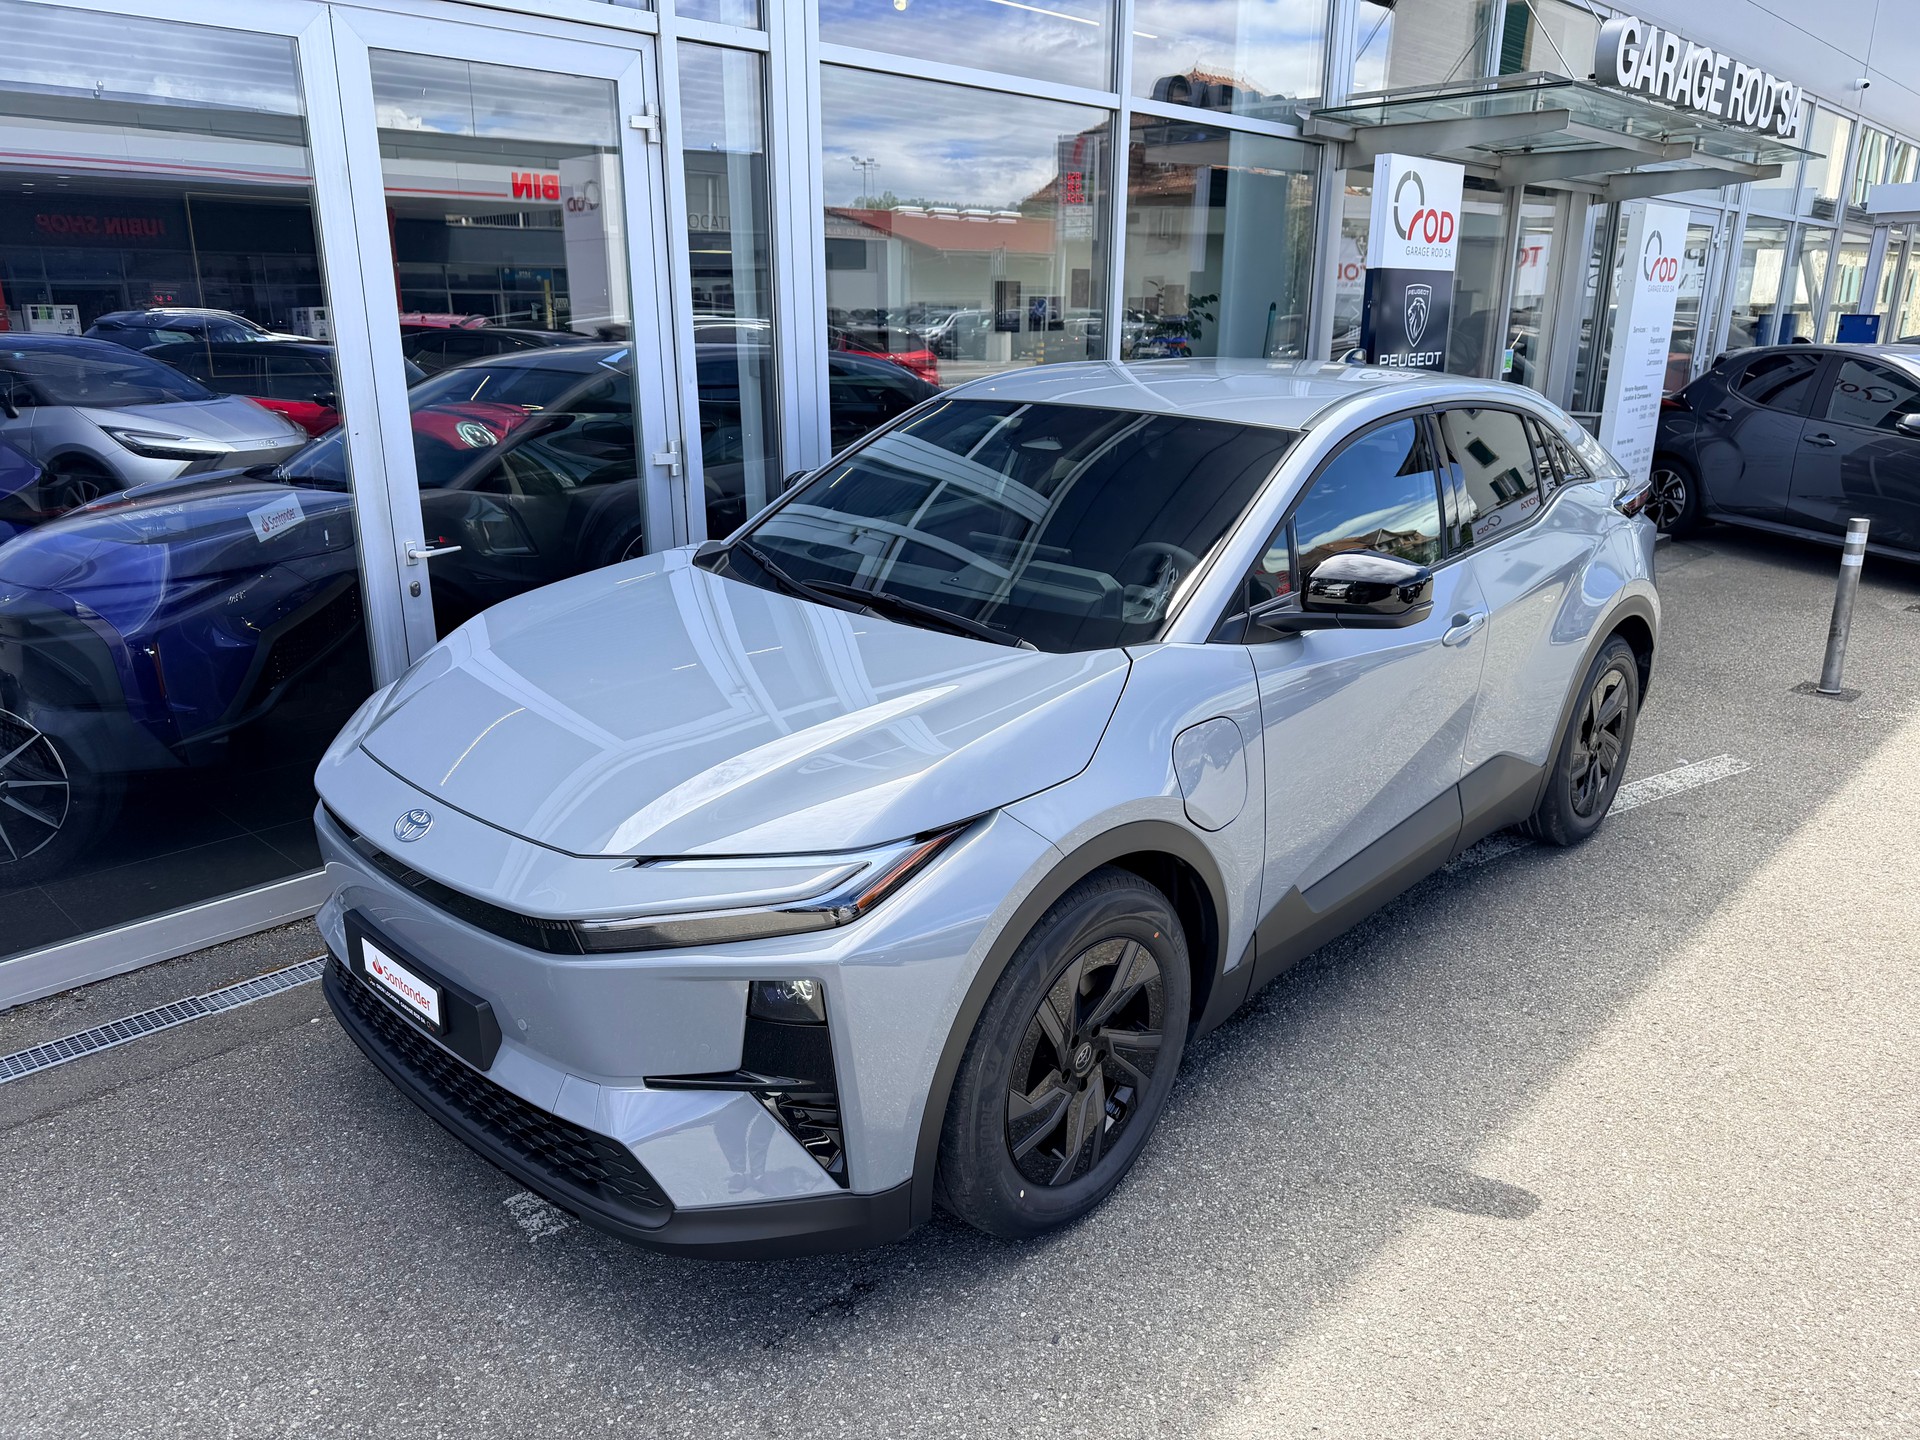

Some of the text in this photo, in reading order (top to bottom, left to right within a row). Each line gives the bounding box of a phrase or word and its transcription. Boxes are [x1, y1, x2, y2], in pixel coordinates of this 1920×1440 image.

[1616, 16, 1802, 138] GARAGE ROD SA
[1405, 245, 1451, 258] GARAGE ROD SA
[1407, 288, 1430, 296] PEUGEOT
[1379, 351, 1442, 367] PEUGEOT
[382, 965, 431, 1011] Santander
